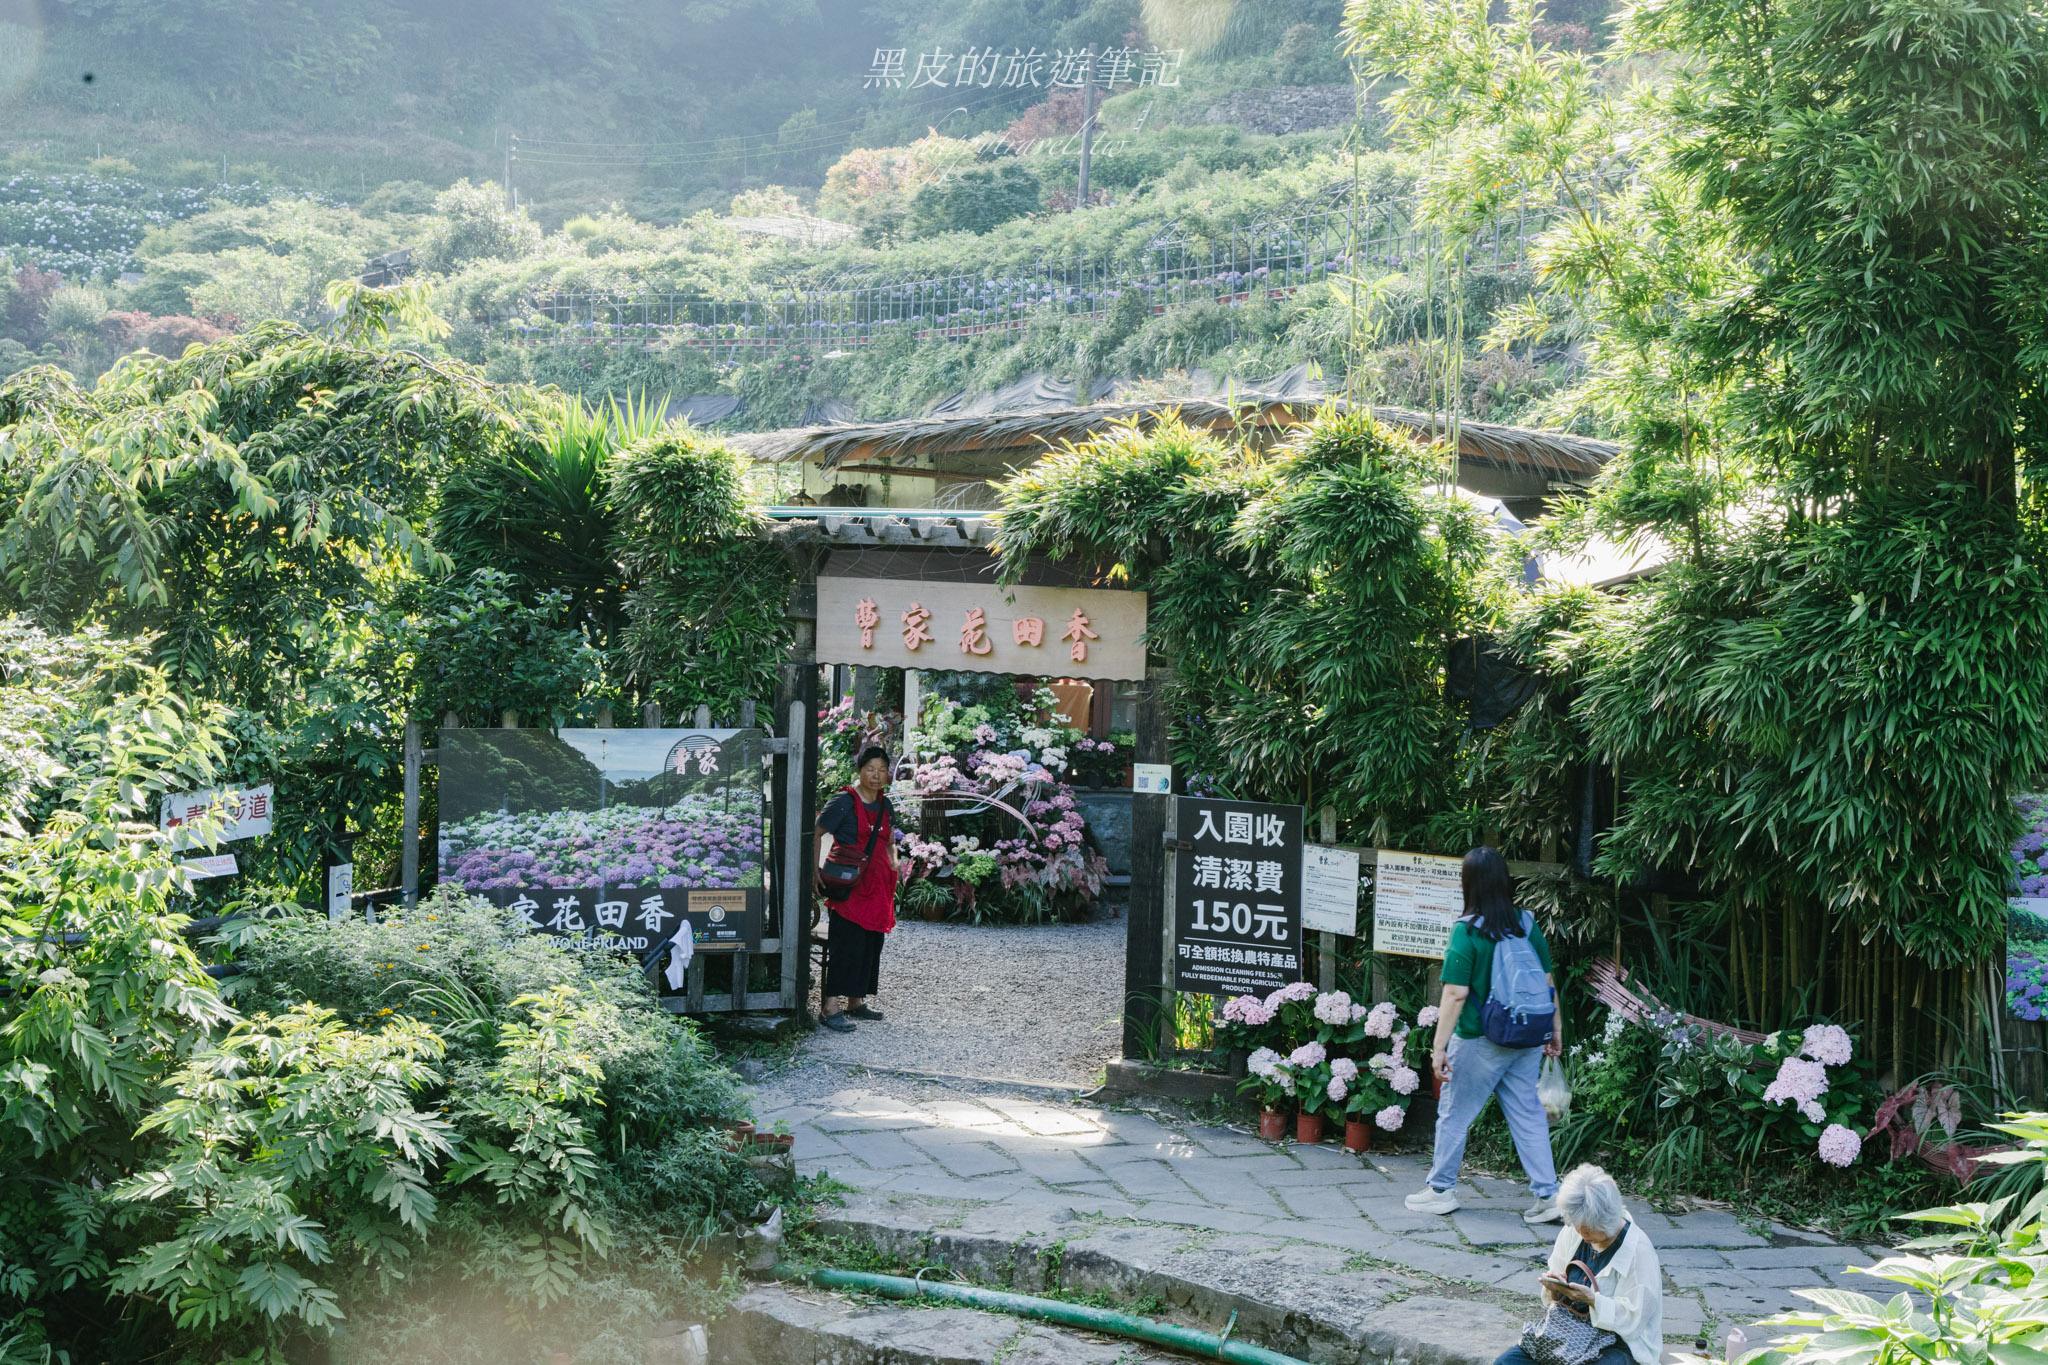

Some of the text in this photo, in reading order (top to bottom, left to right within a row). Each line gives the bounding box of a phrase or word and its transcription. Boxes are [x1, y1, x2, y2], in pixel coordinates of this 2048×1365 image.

[855, 597, 1100, 662] 曹家花田香
[1193, 809, 1285, 847] 入園收
[1192, 855, 1284, 894] 清潔費
[1191, 899, 1288, 941] 150元
[1178, 944, 1297, 969] 可全額抵換農特產品
[1192, 965, 1224, 974] ADMISSION
[1225, 967, 1254, 977] CLEANING
[1255, 970, 1265, 978] FEE
[1199, 973, 1238, 983] REDEEMABLE
[1251, 979, 1286, 988] AGRICULTU
[1221, 984, 1253, 993] PRODUCTS
